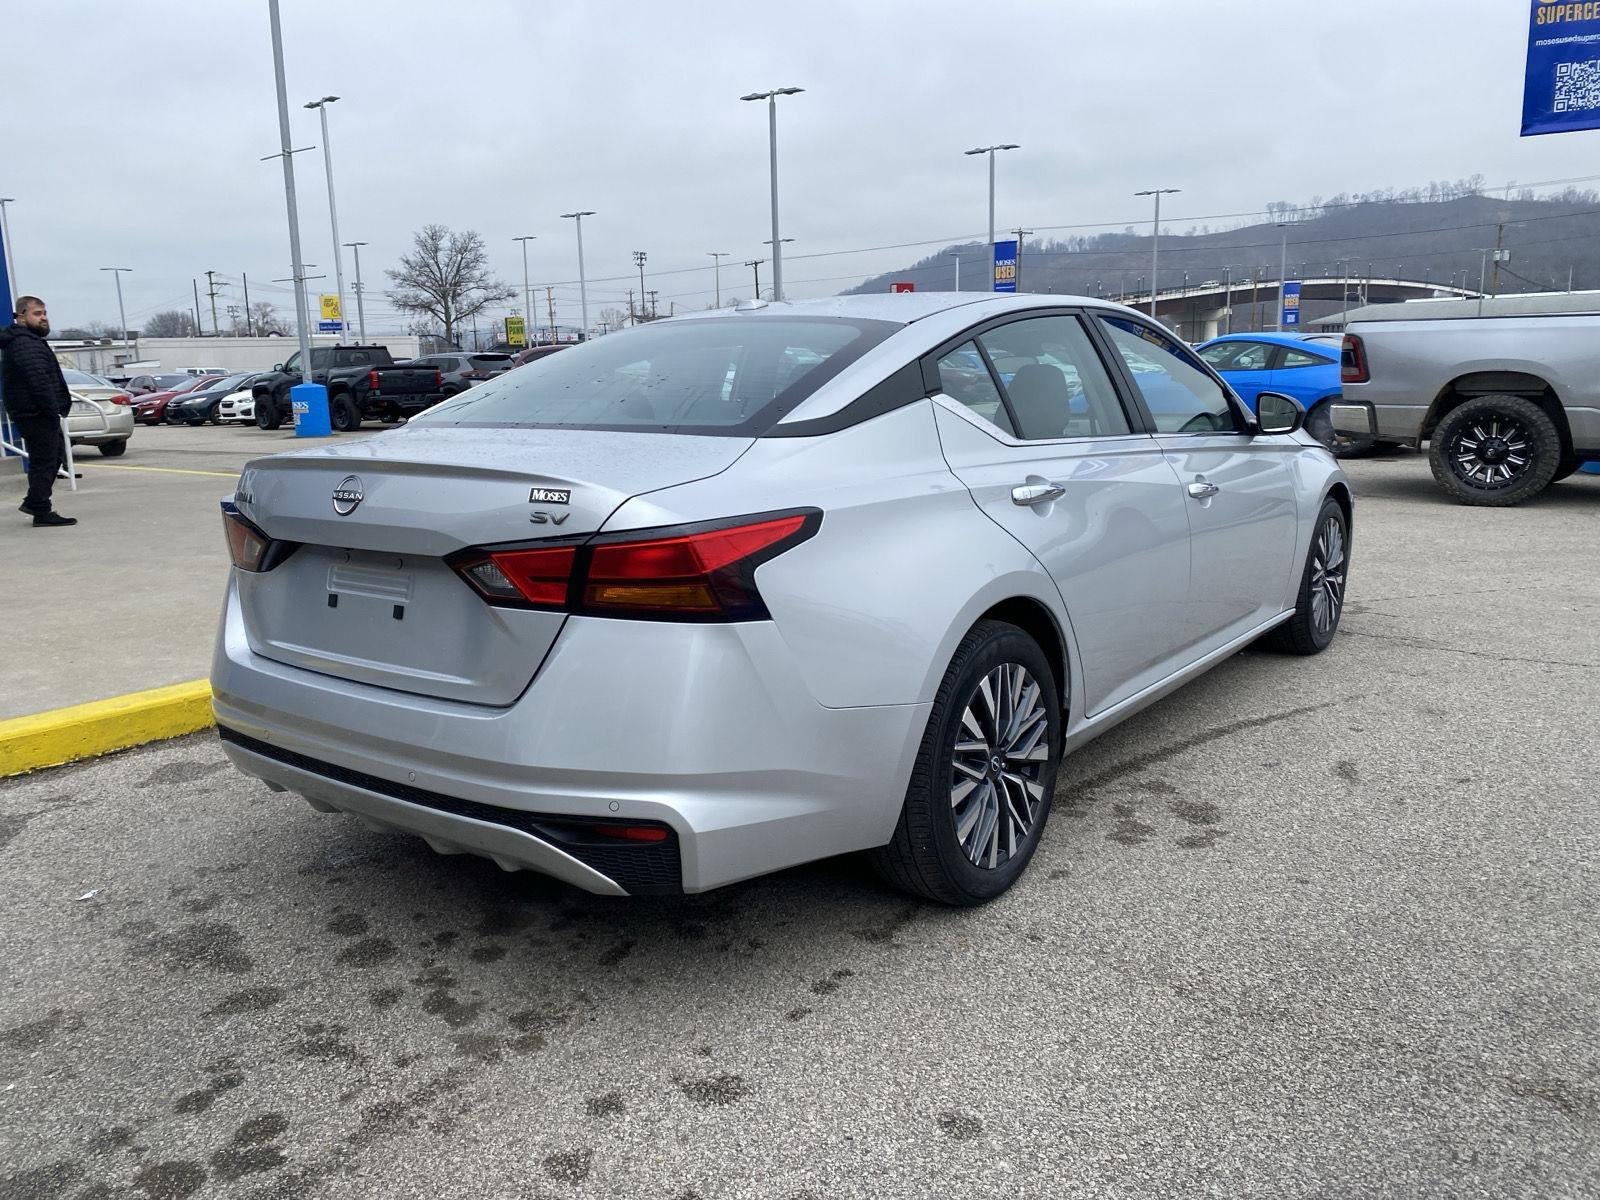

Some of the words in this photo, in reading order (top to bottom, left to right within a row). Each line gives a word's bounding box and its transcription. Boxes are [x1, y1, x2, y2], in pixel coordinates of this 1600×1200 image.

[1536, 2, 1600, 25] SUPERCE
[995, 266, 1015, 279] USED
[333, 491, 363, 500] NISSAN
[531, 489, 568, 502] MOSES
[529, 511, 570, 526] SV
